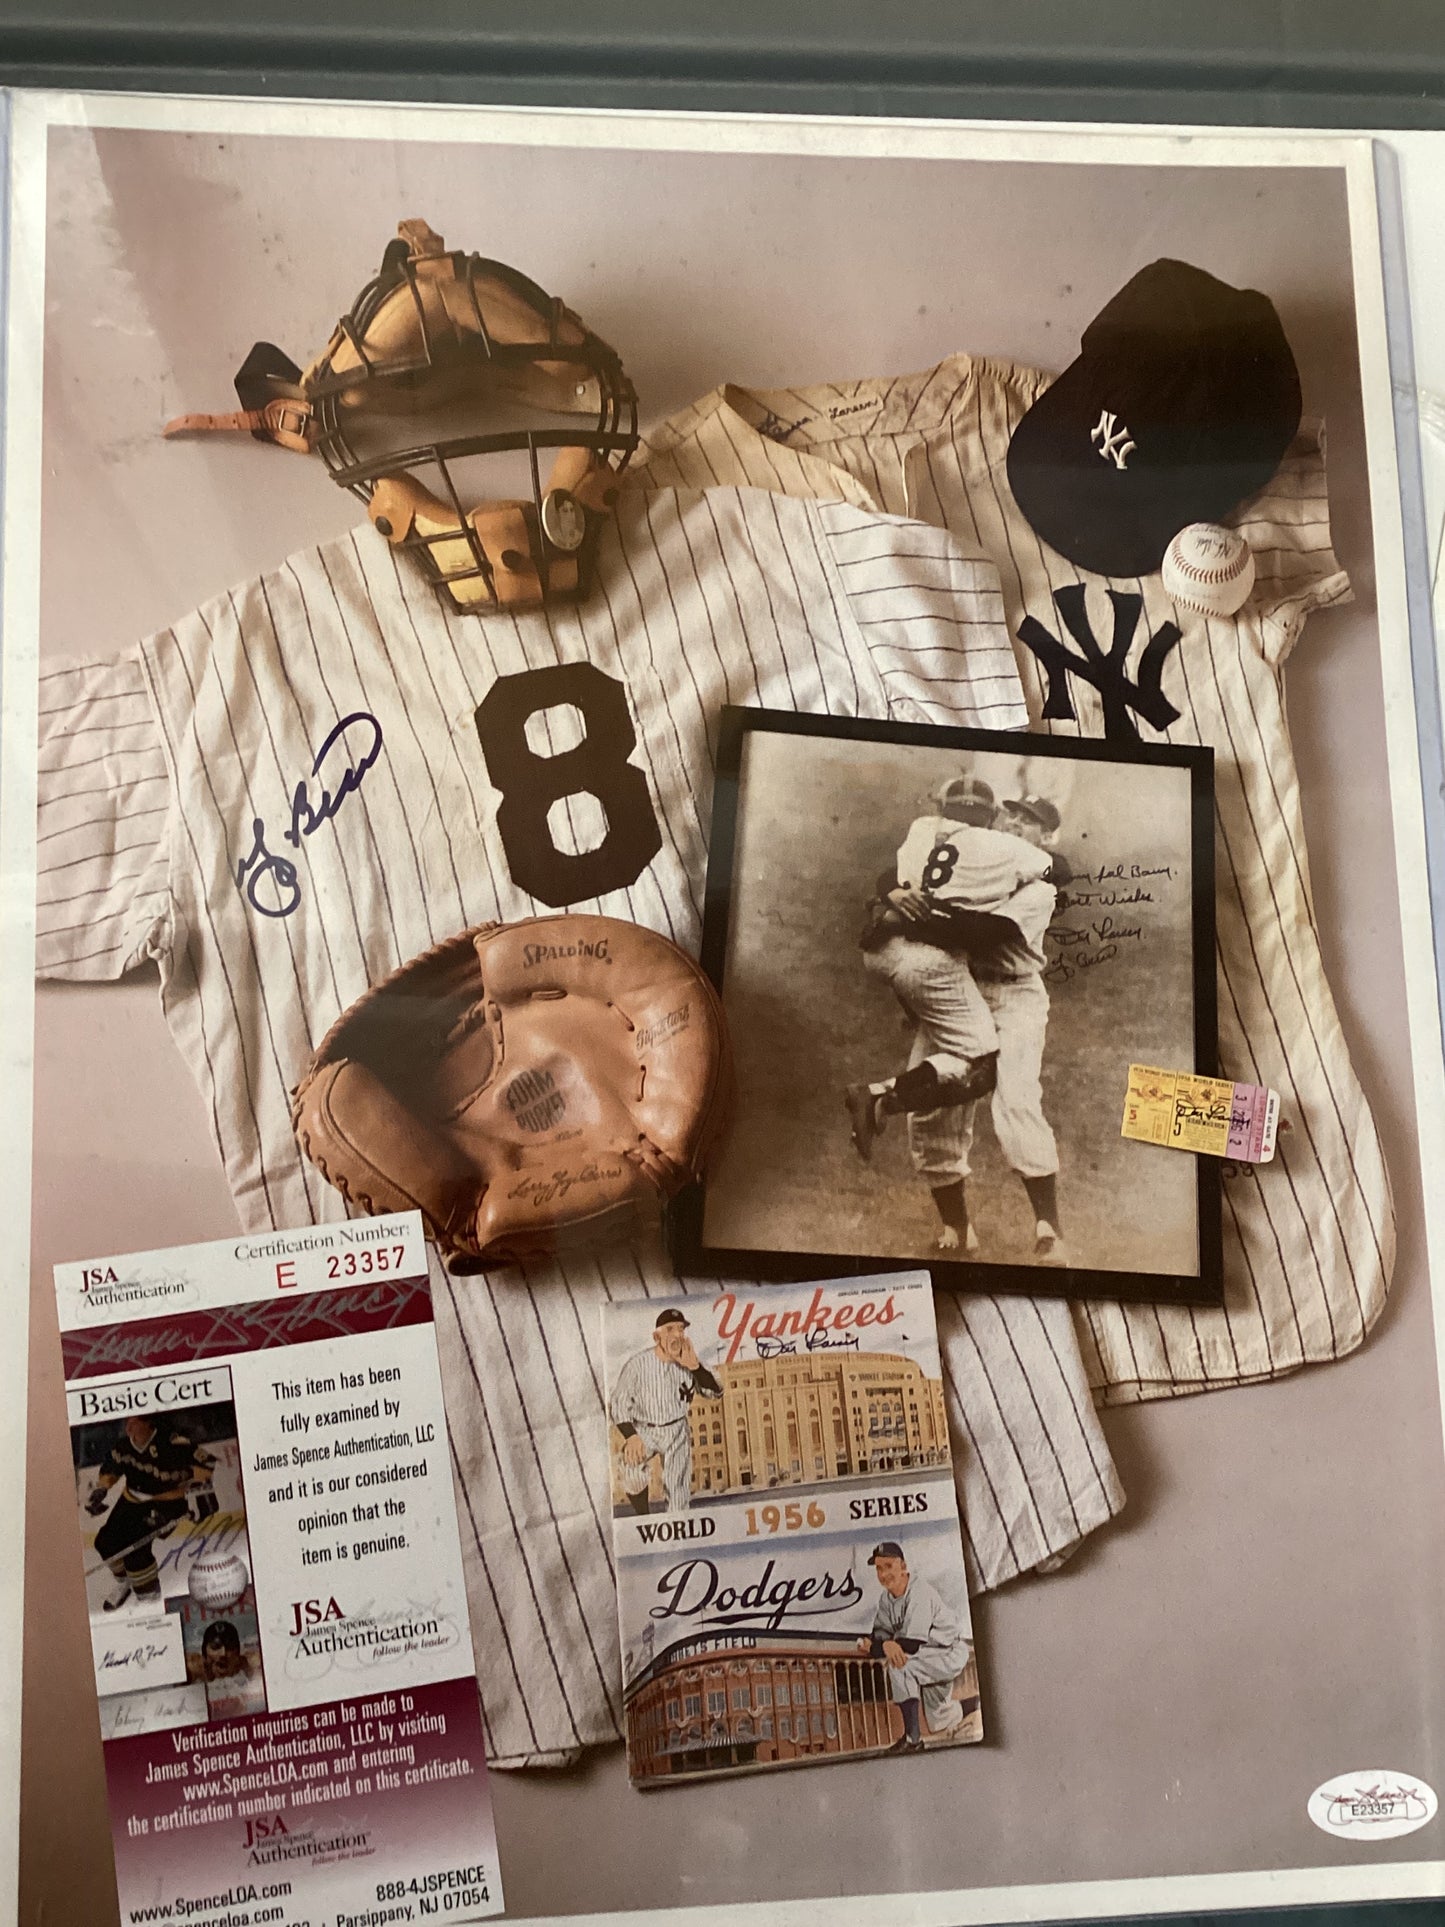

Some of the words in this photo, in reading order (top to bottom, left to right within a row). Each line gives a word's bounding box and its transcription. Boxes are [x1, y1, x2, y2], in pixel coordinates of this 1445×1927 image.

[474, 661, 663, 908] 8
[922, 844, 960, 889] 8
[523, 939, 608, 968] SPALDING
[234, 1235, 334, 1261] Certification
[340, 1224, 410, 1246] Number:
[80, 1266, 118, 1293] JSA
[276, 1261, 297, 1289] E
[327, 1245, 405, 1279] 23357
[83, 1281, 185, 1309] Authentication
[712, 1288, 904, 1365] Yankees
[80, 1387, 148, 1418] Basic
[154, 1378, 213, 1405] Cert
[272, 1381, 302, 1401] This
[306, 1377, 336, 1395] item
[340, 1372, 364, 1390] has
[369, 1367, 401, 1385] been
[280, 1412, 310, 1433] fully
[316, 1400, 379, 1428] examined
[384, 1398, 400, 1417] by
[254, 1454, 288, 1472] James
[292, 1446, 331, 1468] Spence
[334, 1432, 413, 1458] Authentication,
[415, 1424, 435, 1444] LLC
[269, 1482, 293, 1503] and
[298, 1484, 307, 1499] it
[312, 1478, 324, 1496] is
[329, 1477, 351, 1493] our
[355, 1459, 428, 1488] considered
[298, 1509, 348, 1535] opinion
[353, 1503, 380, 1522] that
[384, 1498, 406, 1516] the
[636, 1517, 716, 1544] WORLD
[745, 1501, 827, 1537] 1956
[849, 1492, 929, 1520] SERIES
[302, 1547, 332, 1566] item
[337, 1541, 348, 1560] is
[353, 1533, 410, 1561] genuine.
[649, 1559, 864, 1630] Dodgers
[289, 1595, 346, 1637] JSA
[339, 1617, 376, 1632] Spence
[295, 1619, 438, 1659] Authentication
[373, 1644, 401, 1659] follow
[404, 1641, 418, 1654] the
[421, 1635, 450, 1649] leader
[715, 1636, 757, 1651] FIELD
[172, 1723, 248, 1753] Verification
[252, 1712, 309, 1740] inquiries
[314, 1709, 336, 1729] can
[341, 1702, 357, 1723] be
[362, 1695, 396, 1719] made
[400, 1694, 414, 1712] to
[145, 1761, 189, 1784] James
[192, 1753, 241, 1778] Spence
[246, 1732, 346, 1766] Authentication,
[350, 1722, 375, 1746] LLC
[378, 1720, 394, 1744] by
[398, 1711, 447, 1737] visiting
[183, 1760, 329, 1802] www.SpenceLOA.com
[333, 1750, 357, 1773] and
[362, 1742, 415, 1769] entering
[128, 1815, 149, 1837] the
[154, 1800, 233, 1833] certification
[238, 1791, 286, 1817] number
[291, 1775, 351, 1807] indicated
[355, 1778, 371, 1795] on
[376, 1768, 400, 1791] this
[405, 1757, 474, 1786] certificate.
[1351, 1803, 1395, 1817] E23357
[242, 1814, 288, 1849] JSA
[247, 1831, 367, 1869] Authentication
[130, 1881, 292, 1924] www.SpenceLOA.com
[375, 1865, 486, 1902] 888-4JSPENCE
[337, 1904, 416, 1927] Parsippany,
[419, 1897, 439, 1916] NJ
[443, 1886, 490, 1911] 07054
